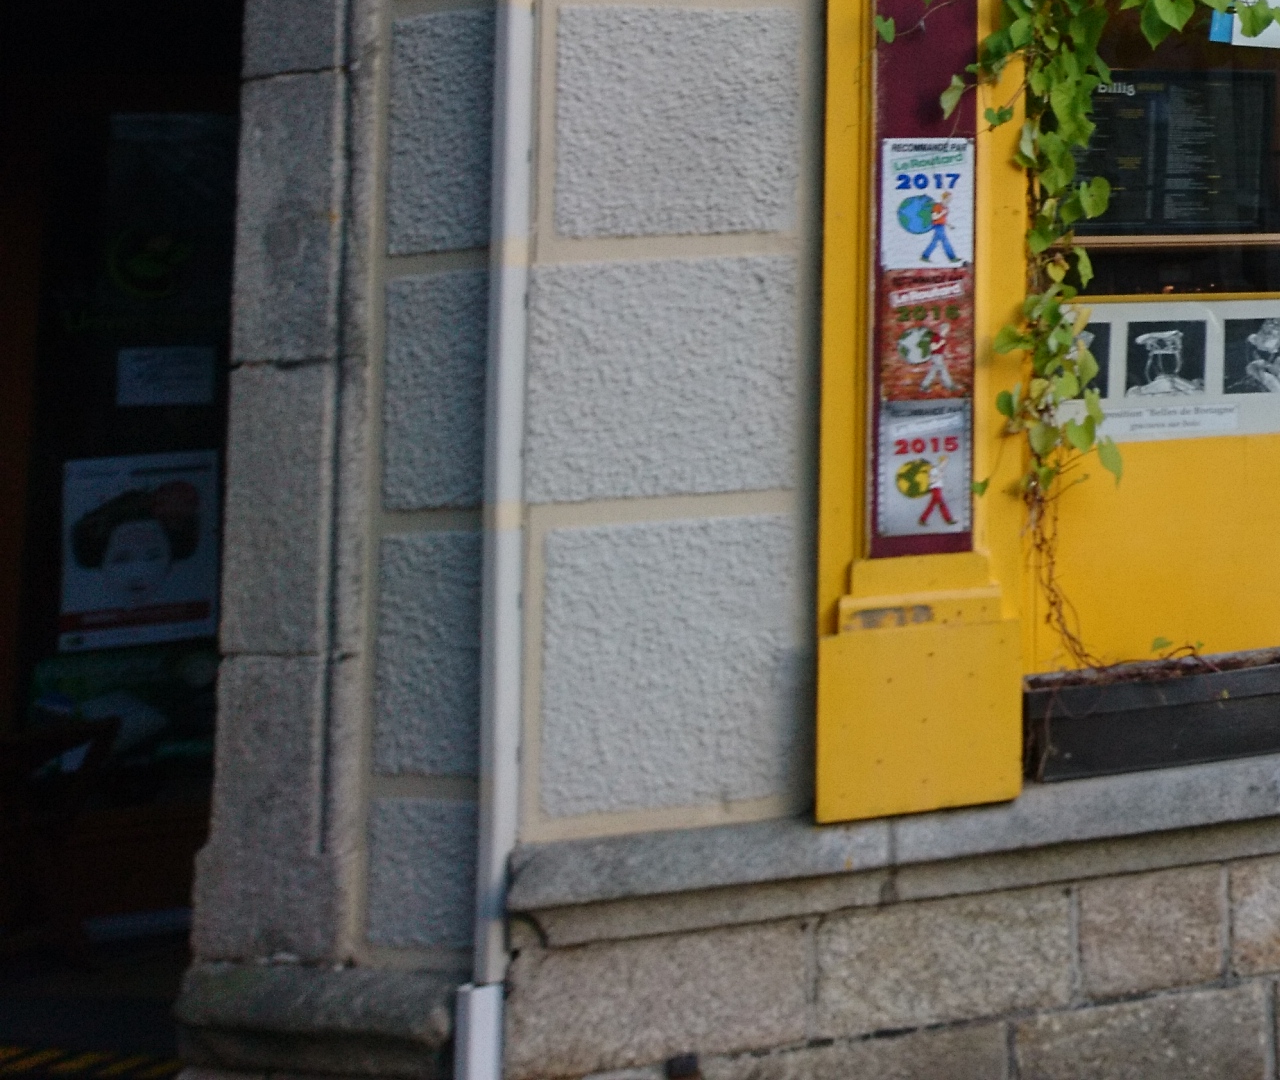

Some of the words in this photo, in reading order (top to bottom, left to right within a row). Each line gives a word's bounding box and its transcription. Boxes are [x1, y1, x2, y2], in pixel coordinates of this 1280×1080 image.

[949, 142, 968, 152] PAR
[895, 172, 961, 191] 2017
[894, 435, 960, 455] 2015
